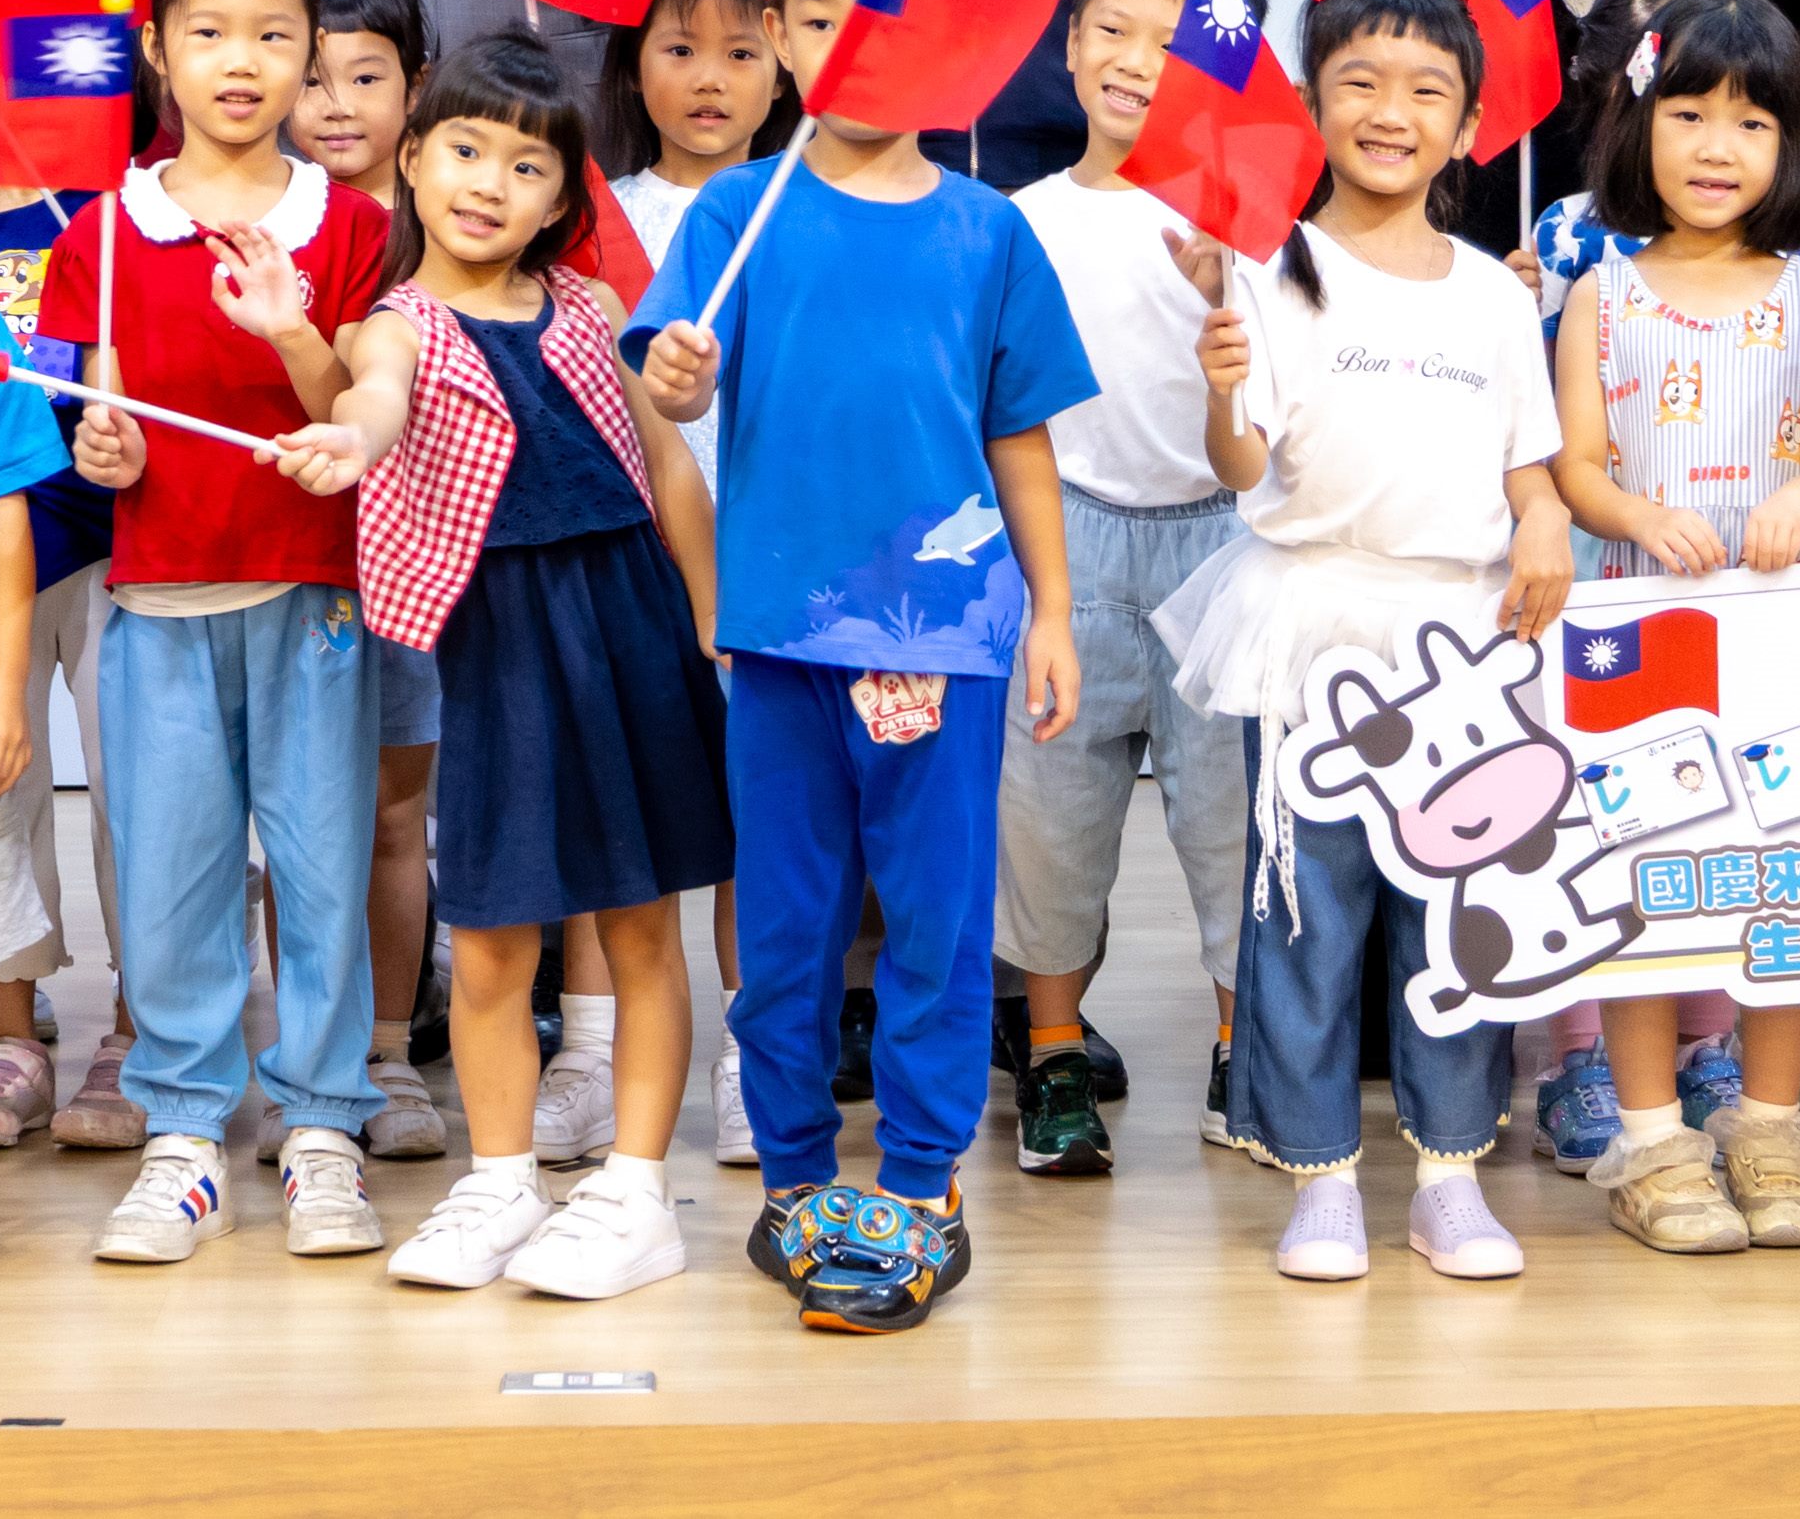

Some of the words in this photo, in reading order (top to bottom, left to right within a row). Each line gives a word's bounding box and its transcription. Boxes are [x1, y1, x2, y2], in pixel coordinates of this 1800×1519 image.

[1331, 346, 1390, 373] Bon
[1421, 353, 1488, 393] Courage
[1688, 465, 1751, 482] BINGO
[849, 671, 947, 721] PAW
[877, 711, 933, 735] PATROL
